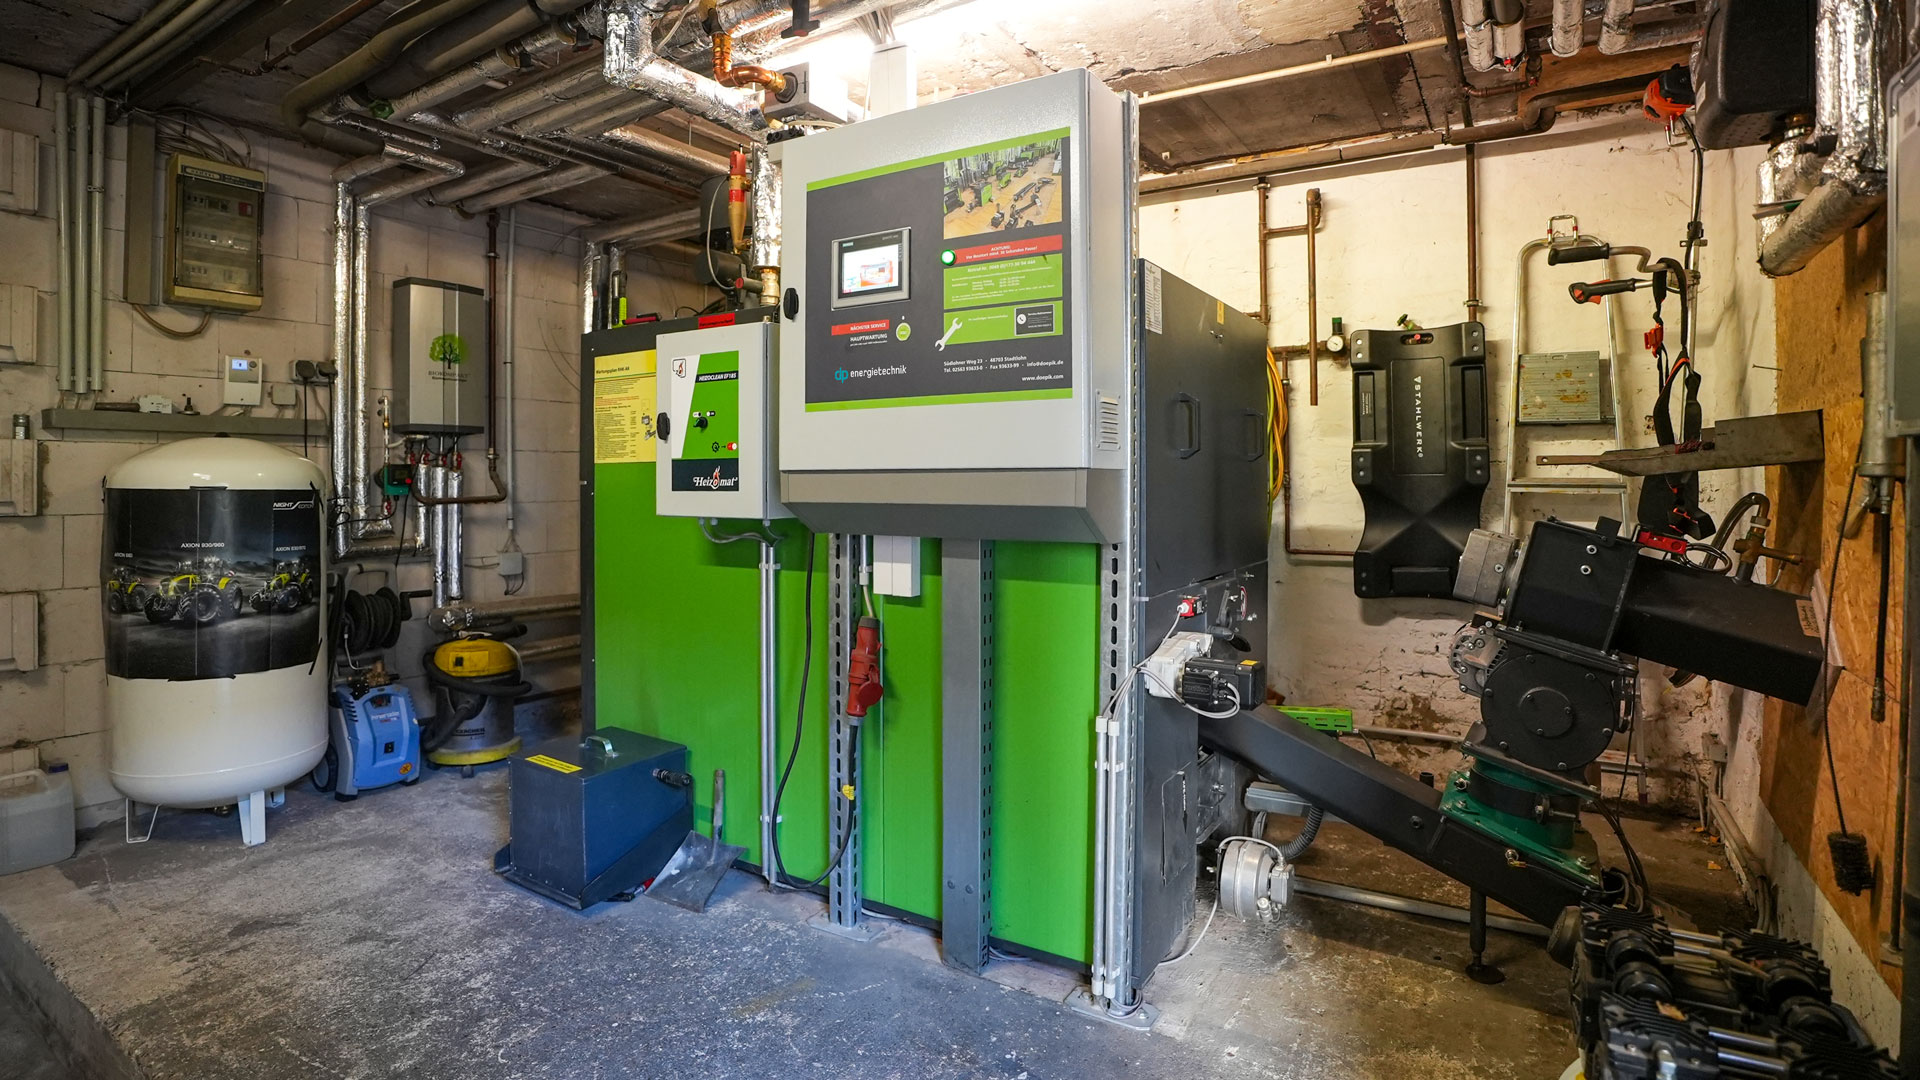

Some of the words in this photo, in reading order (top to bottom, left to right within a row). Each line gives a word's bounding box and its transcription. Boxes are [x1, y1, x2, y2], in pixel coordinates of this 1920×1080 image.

[850, 333, 887, 342] HAUPTWARTUNG
[698, 374, 724, 382] HEIZOCLEAN
[834, 367, 849, 384] dp
[850, 364, 907, 379] energietechnik
[1022, 374, 1064, 382] www.doepik.com
[693, 475, 738, 490] Heizomat
